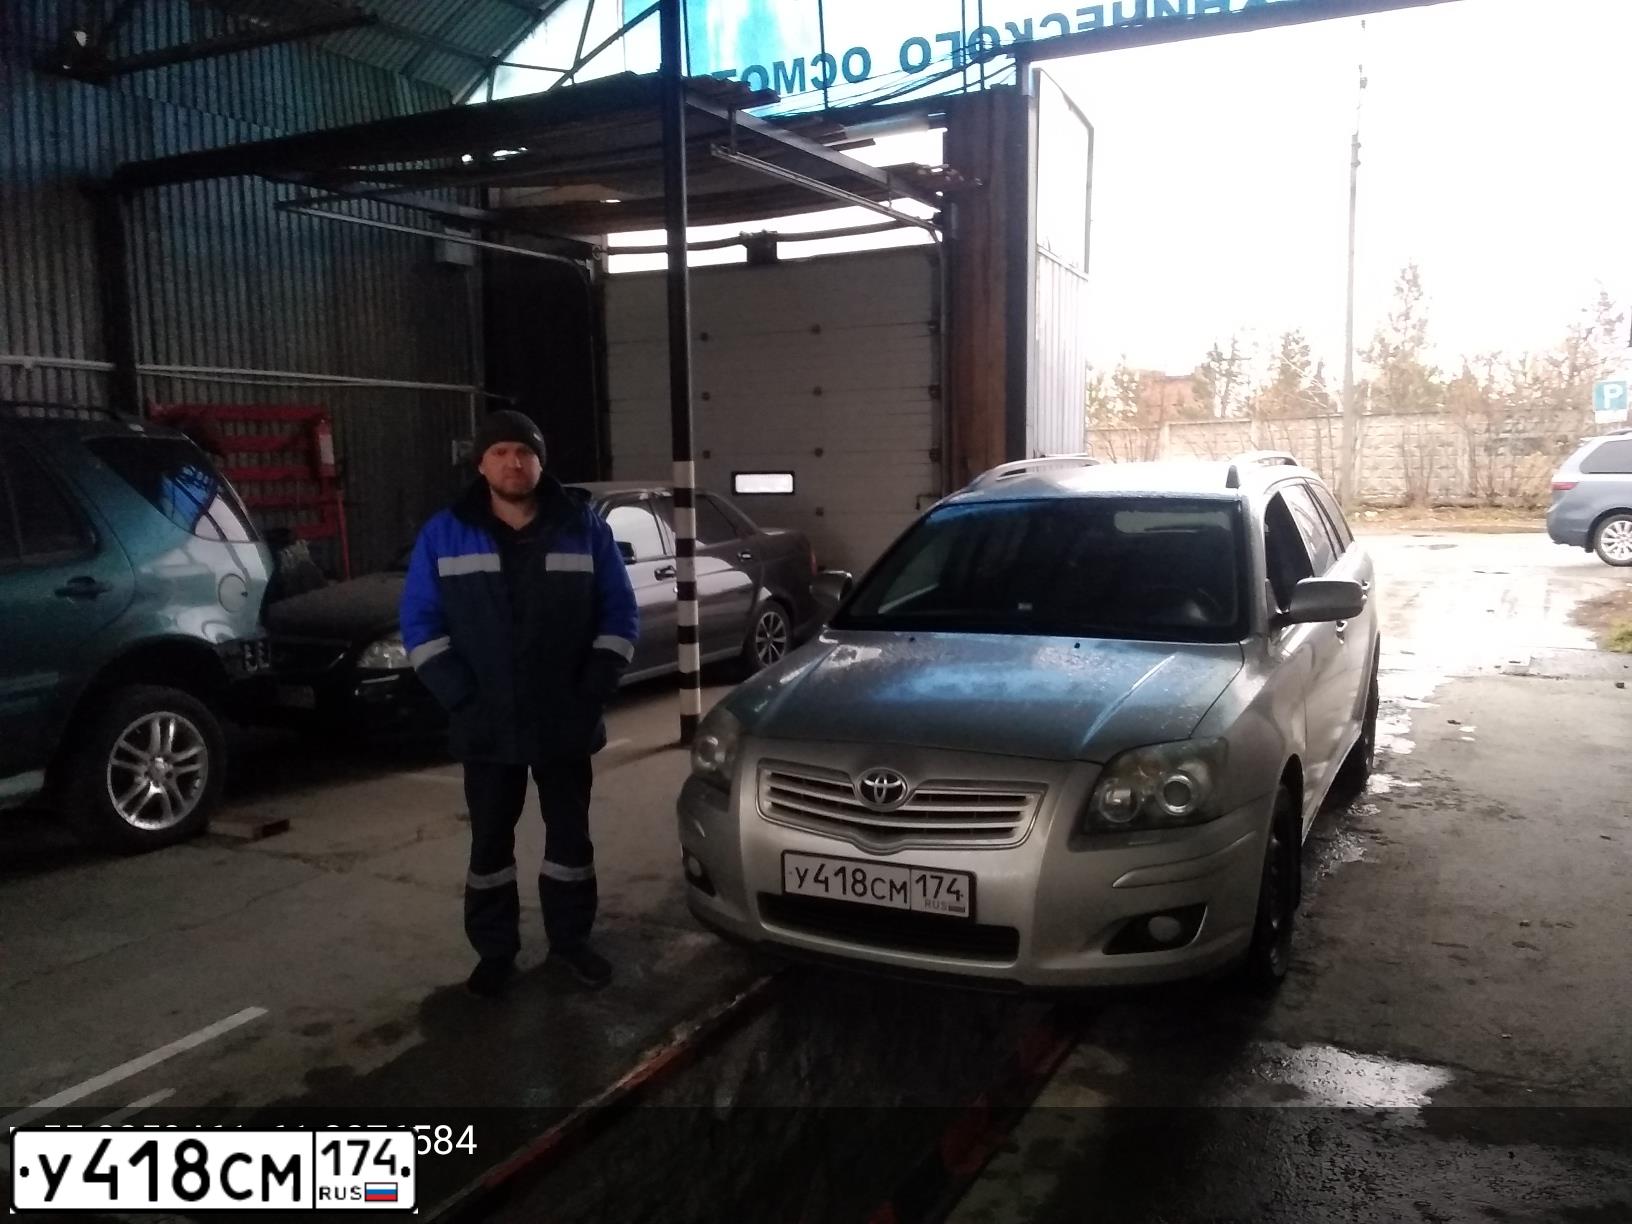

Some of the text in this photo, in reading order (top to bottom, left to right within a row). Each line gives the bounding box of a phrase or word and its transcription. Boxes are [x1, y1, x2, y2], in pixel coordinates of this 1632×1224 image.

[1603, 383, 1623, 409] P
[795, 863, 962, 904] У418СМ 174
[924, 900, 947, 911] RUS
